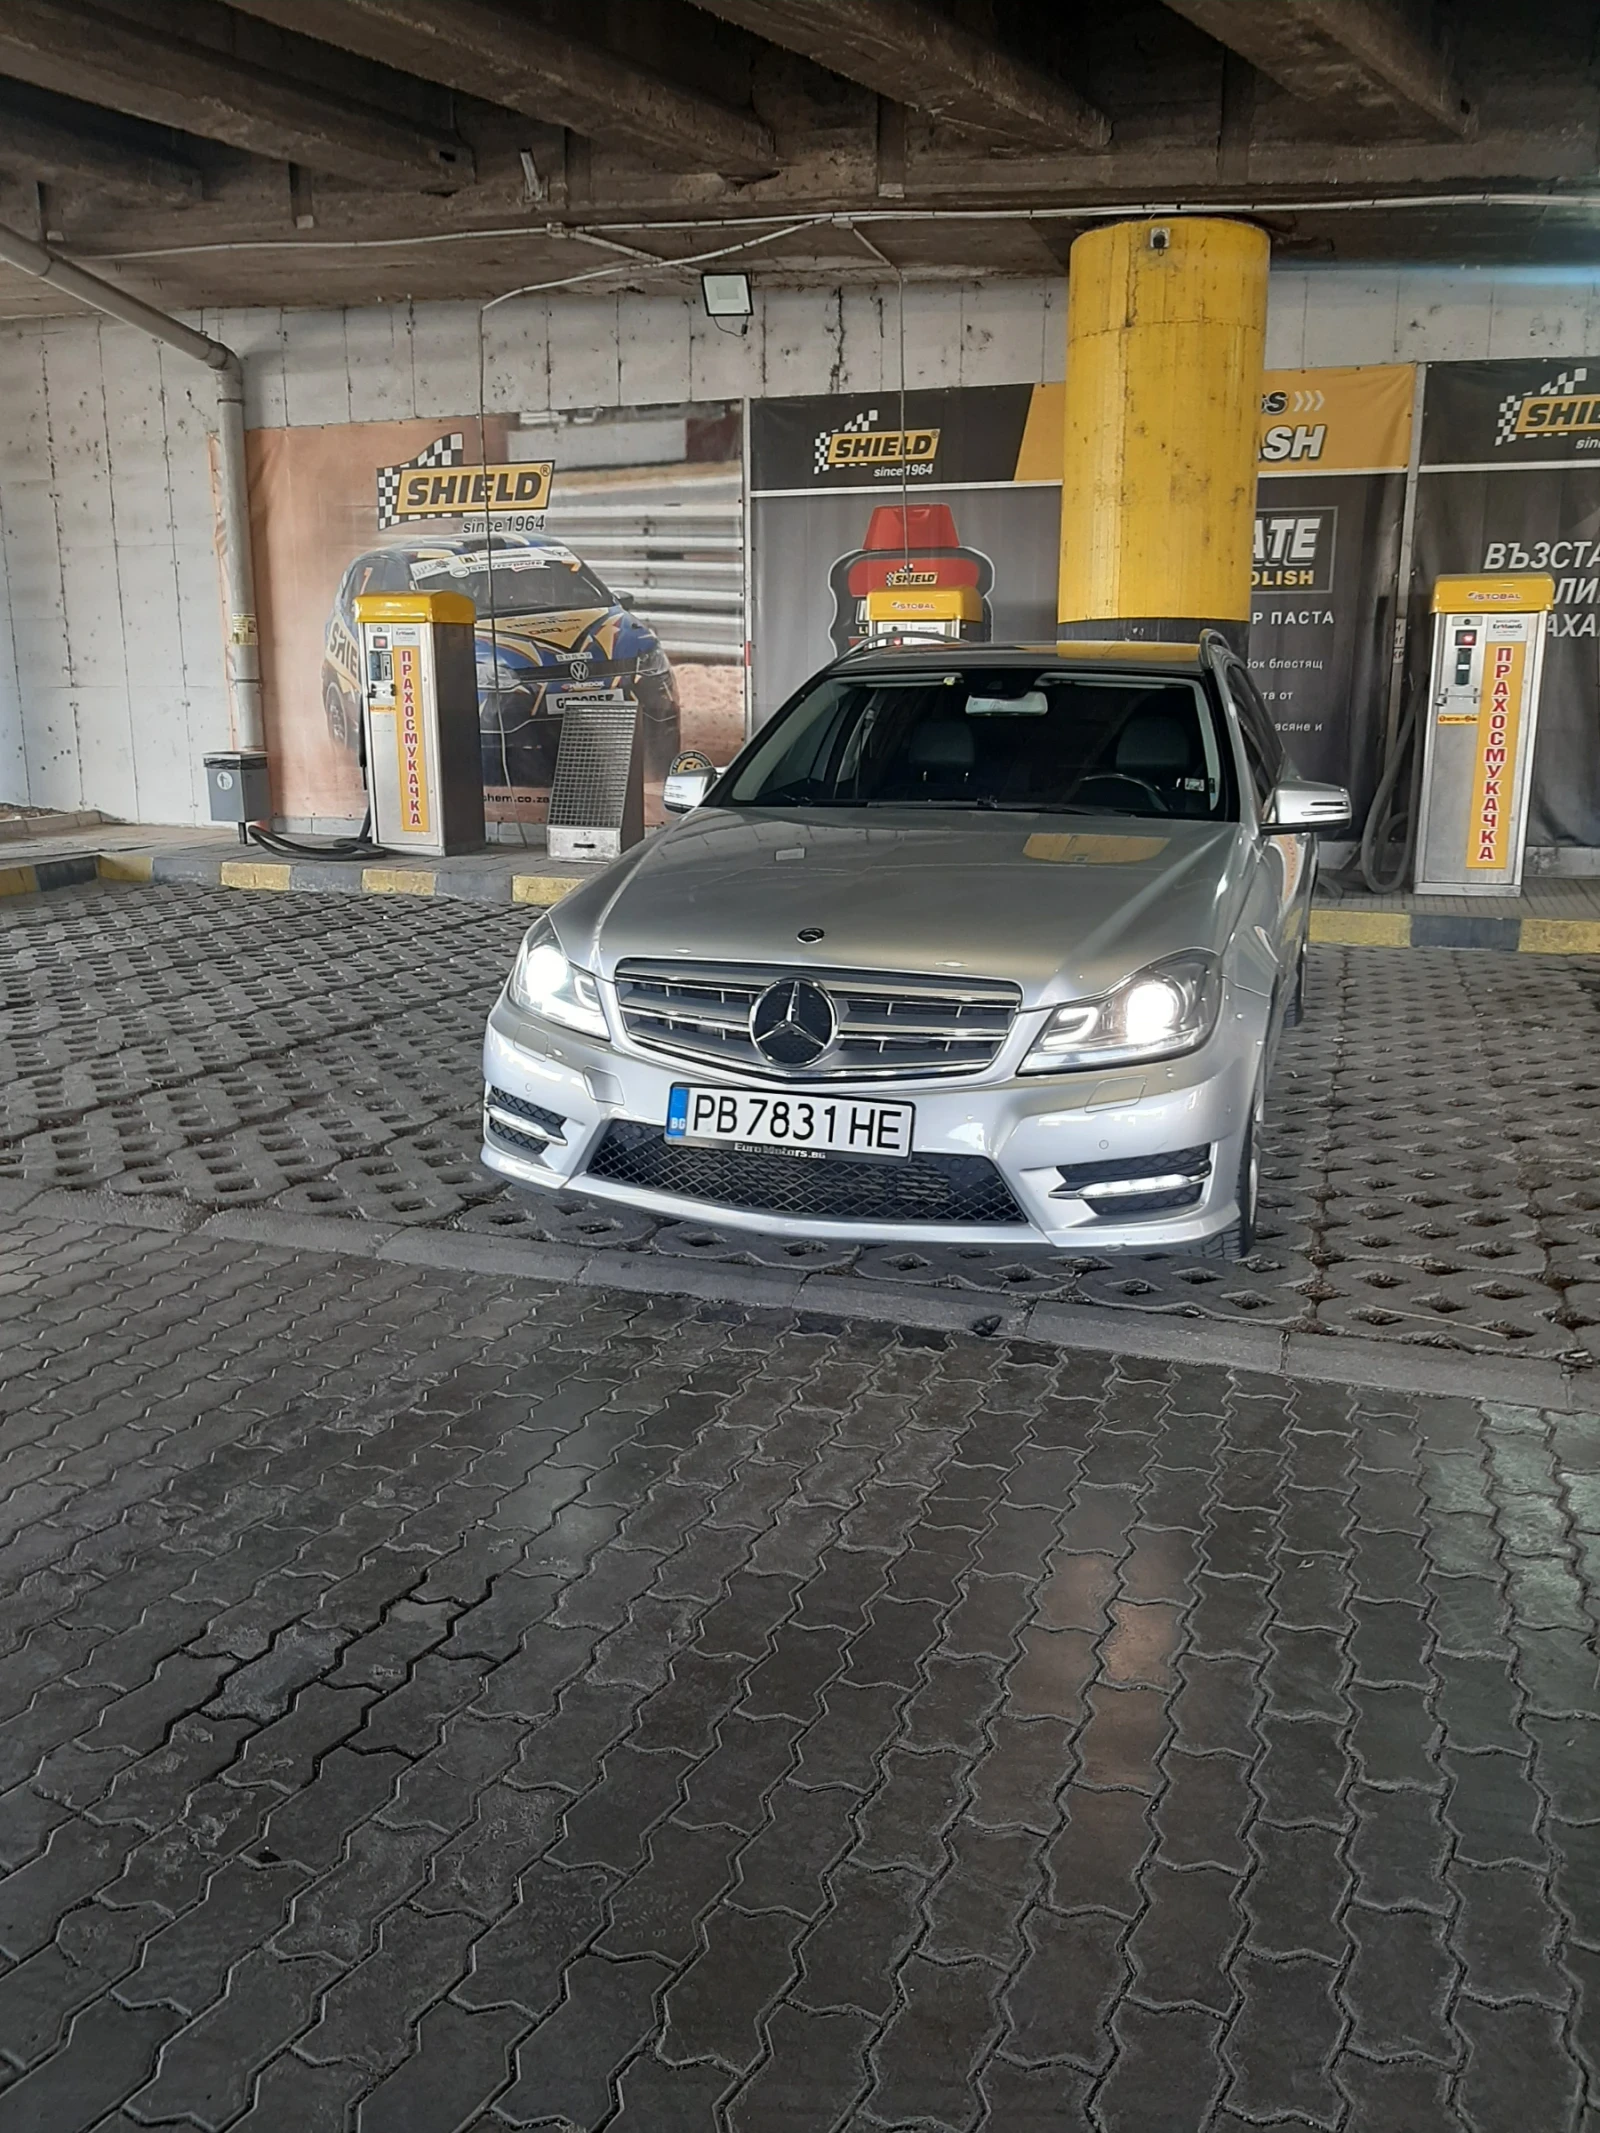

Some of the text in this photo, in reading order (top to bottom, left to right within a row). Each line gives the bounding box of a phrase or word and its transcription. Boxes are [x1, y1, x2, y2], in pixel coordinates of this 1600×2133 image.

[1261, 390, 1288, 414] S
[835, 434, 933, 459] SHIELD
[1258, 424, 1327, 461] SH
[406, 471, 542, 507] SHIELD
[463, 514, 546, 534] since 1964
[1271, 610, 1335, 625] ПАСТА
[1269, 658, 1323, 670] блестящ
[401, 650, 421, 825] ПРАХОСМУКАЧКА
[1478, 647, 1513, 860] ПРАХОСМУКАЧКА
[670, 1117, 687, 1130] BG
